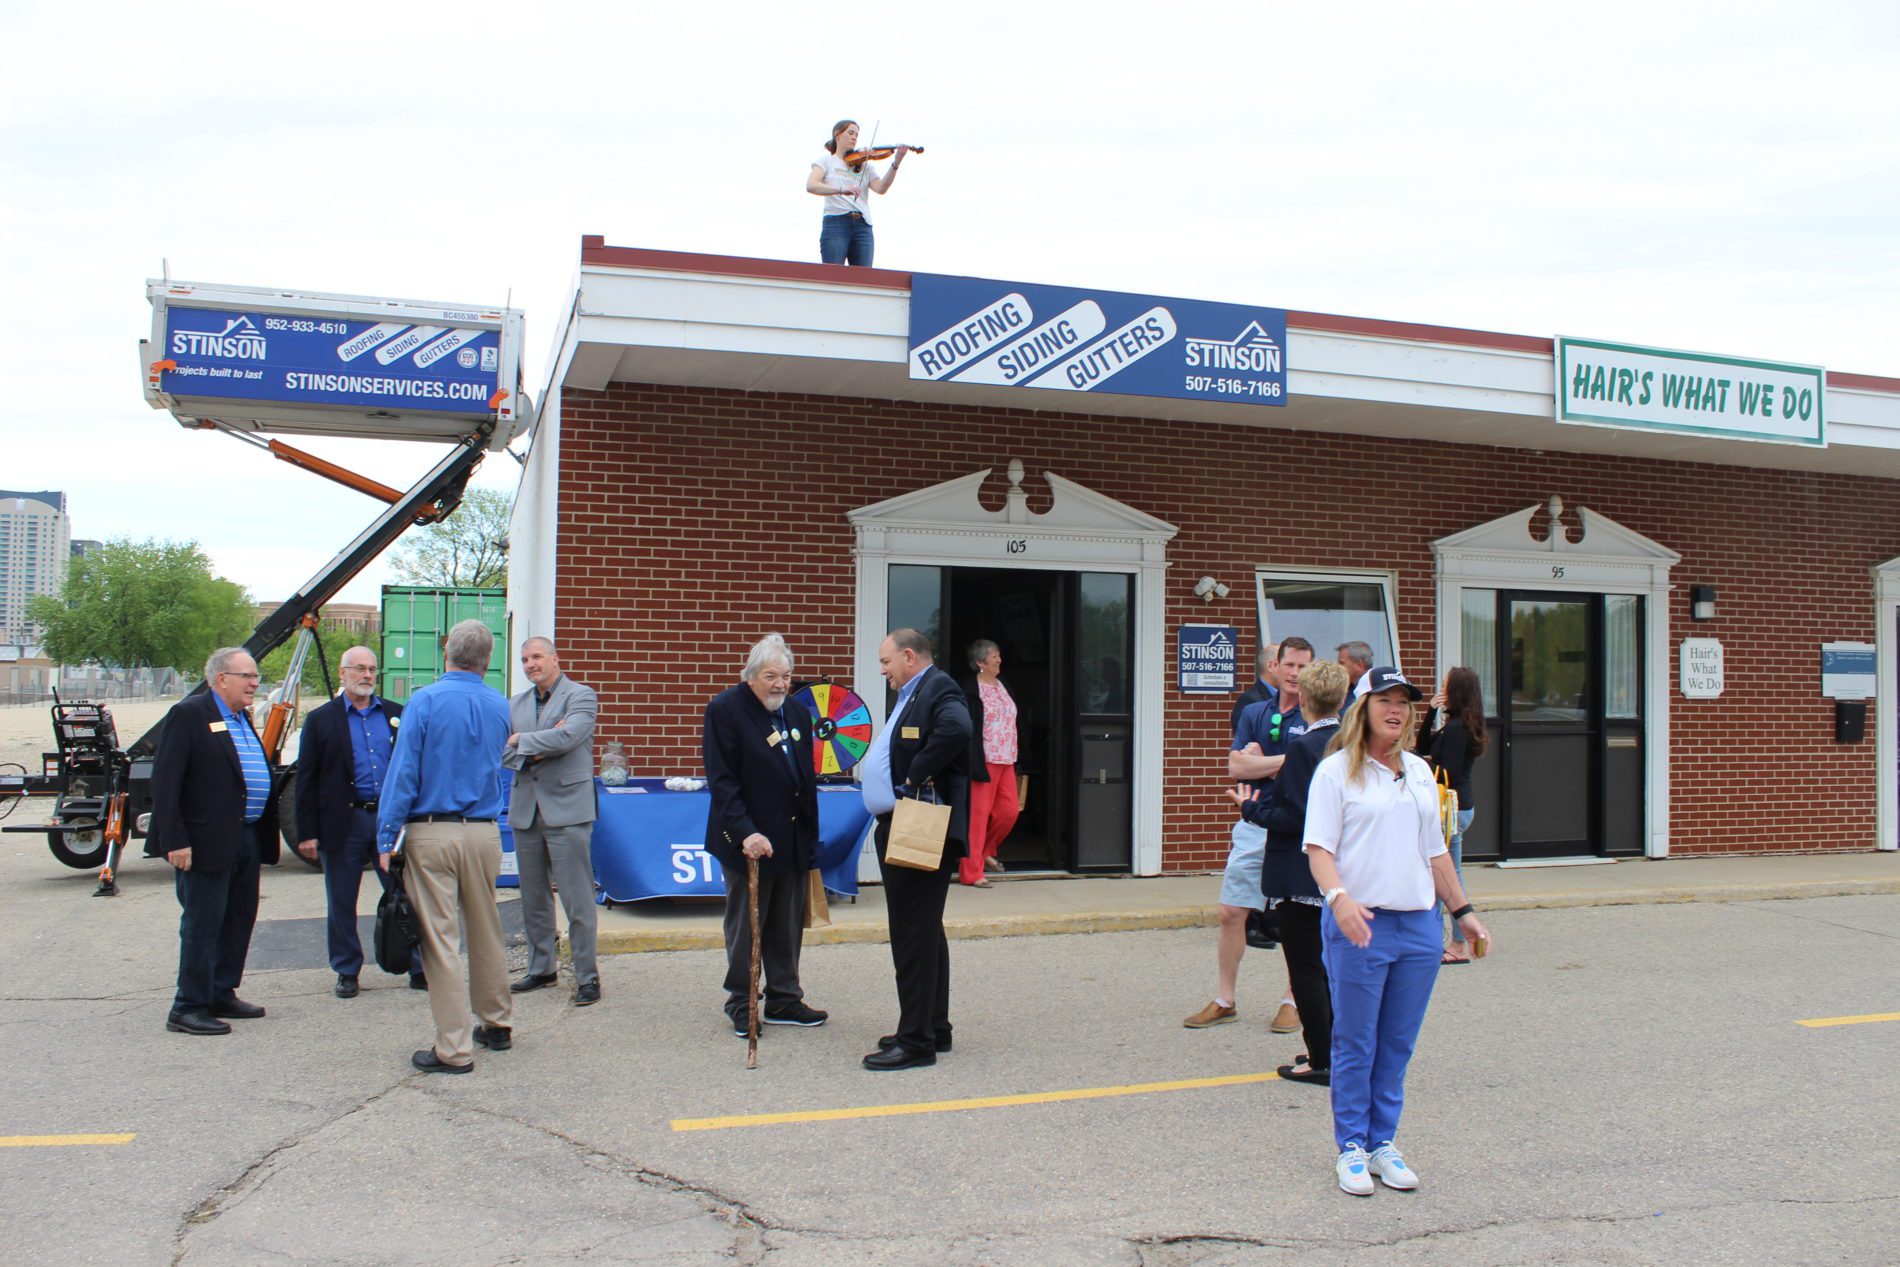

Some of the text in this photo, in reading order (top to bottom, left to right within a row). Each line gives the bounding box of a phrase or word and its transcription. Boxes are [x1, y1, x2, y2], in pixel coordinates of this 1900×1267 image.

[265, 318, 347, 335] 952-933-4510
[173, 334, 267, 360] STINSON
[343, 329, 385, 358] ROOFING
[386, 334, 419, 359] SIDING
[419, 335, 460, 364] GUTTERS
[917, 300, 1024, 377] ROOFING
[997, 319, 1079, 380] SIDING
[1065, 317, 1166, 389] GUTTERS
[1185, 342, 1281, 373] STINSON
[169, 366, 263, 380] rojects built to last
[286, 373, 488, 401] STINSONSERVICES.COM
[1185, 375, 1281, 397] 507-516-7166
[1573, 363, 1812, 421] HAIR'S WHAT WE DO
[1007, 540, 1026, 553] 105
[1552, 566, 1565, 578] 95
[1182, 646, 1234, 660] STINSON
[1690, 647, 1718, 659] Hair's
[1182, 662, 1234, 671] 507-516-7166
[1691, 663, 1717, 674] What
[1688, 678, 1721, 690] We Do
